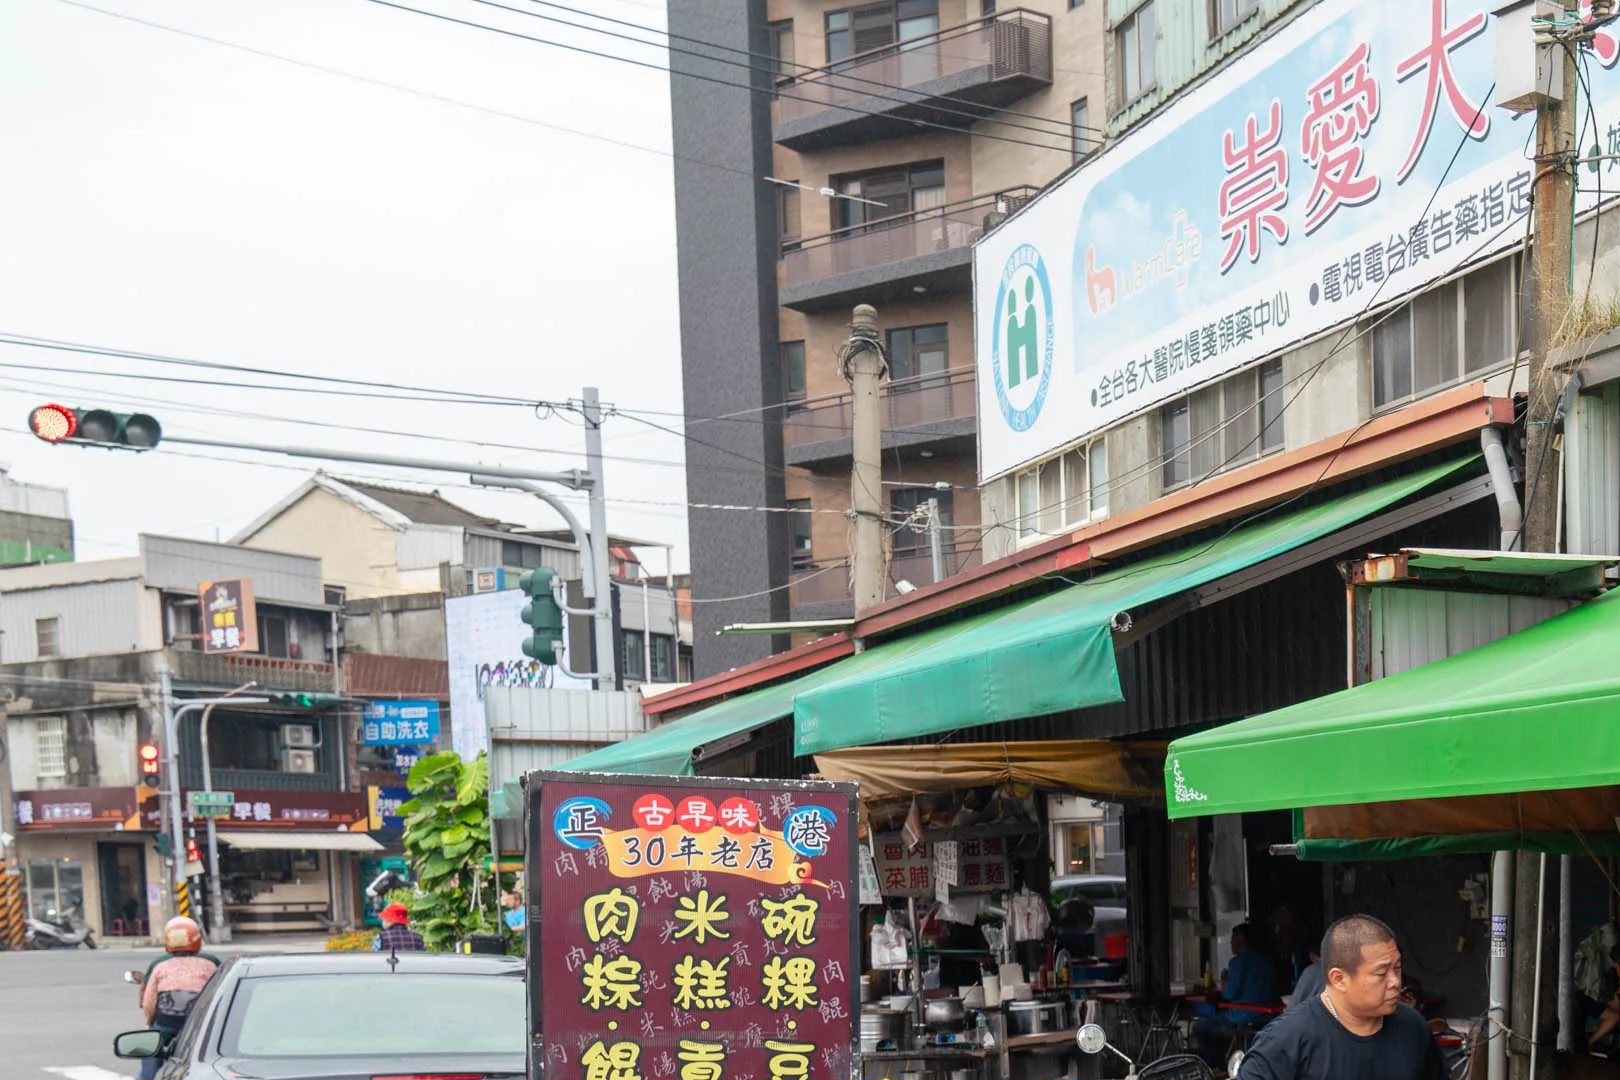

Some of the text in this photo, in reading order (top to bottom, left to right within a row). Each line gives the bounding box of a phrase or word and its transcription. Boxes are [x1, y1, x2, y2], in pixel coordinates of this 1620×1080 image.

[365, 720, 430, 741] 自助洗衣
[562, 806, 605, 836] 正
[638, 798, 756, 829] 古早味
[789, 811, 831, 849] 港
[623, 834, 775, 870] 30年老店
